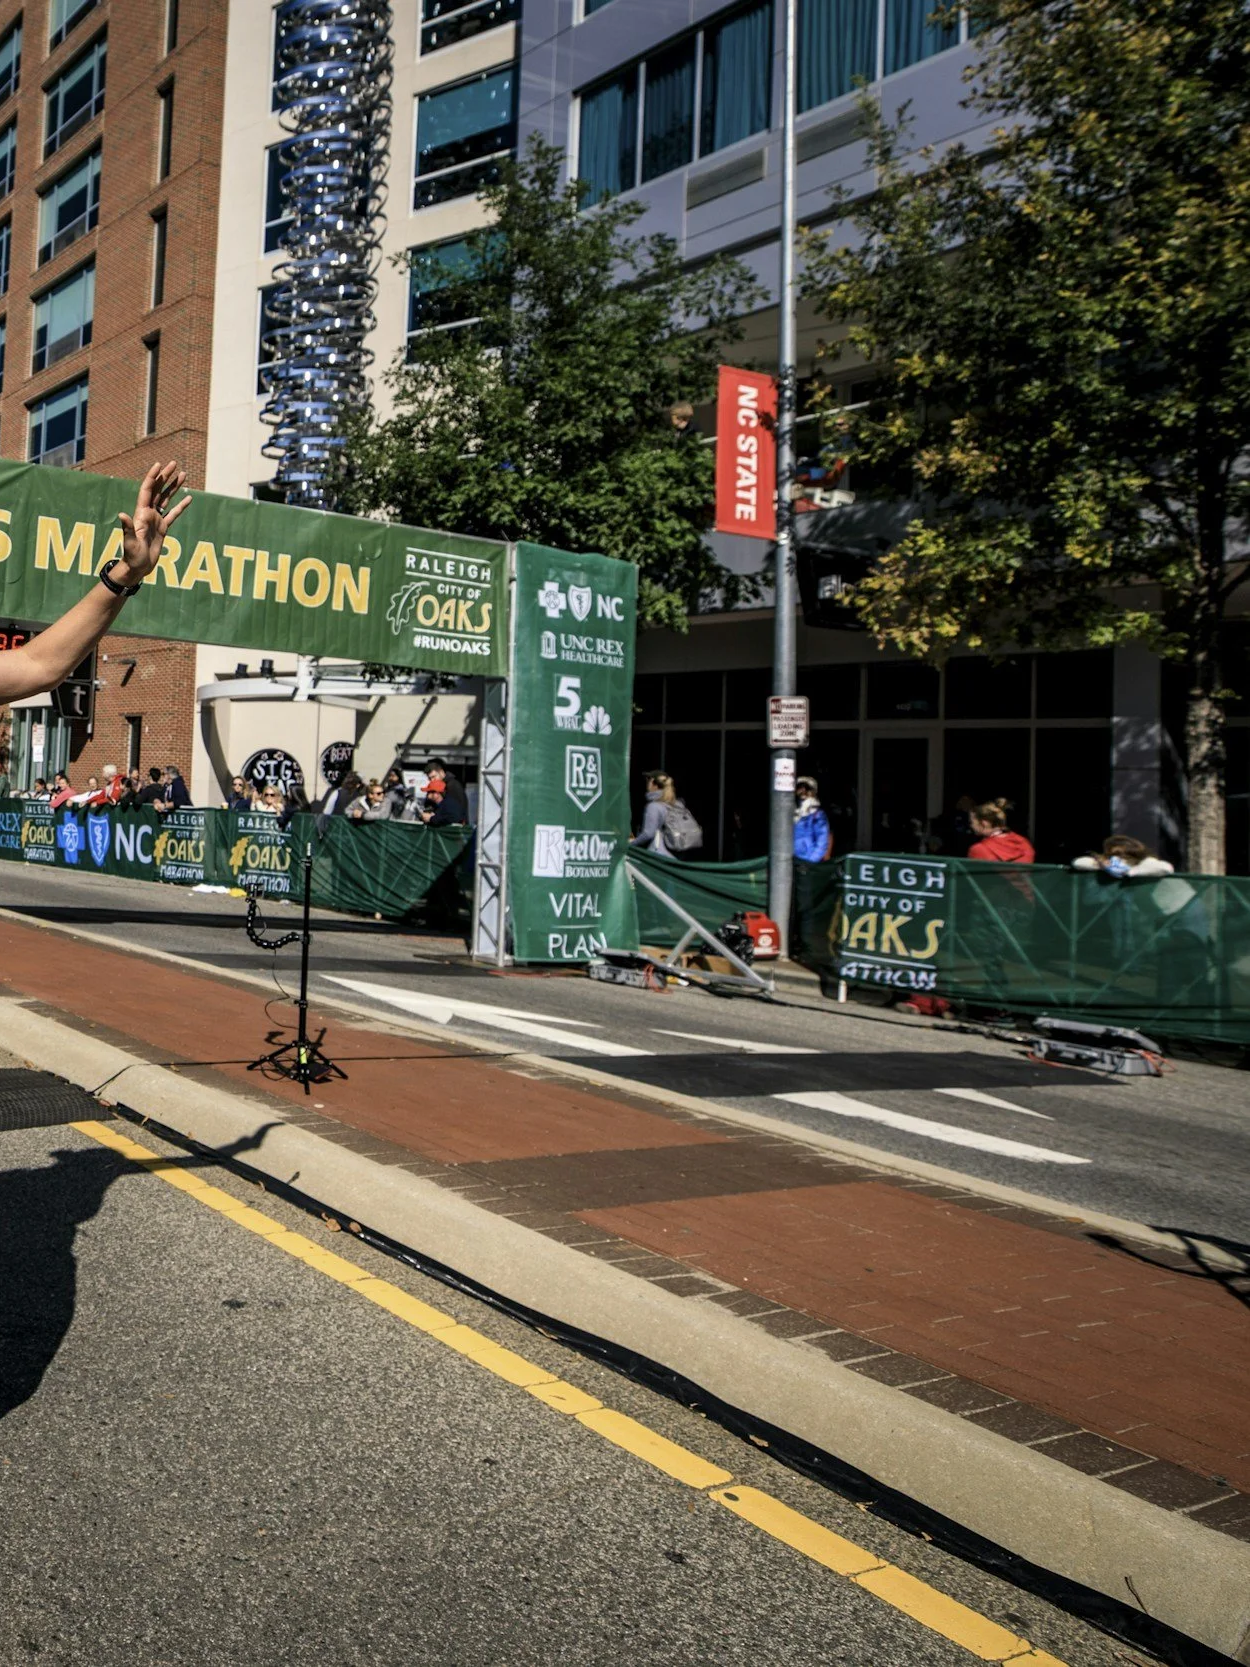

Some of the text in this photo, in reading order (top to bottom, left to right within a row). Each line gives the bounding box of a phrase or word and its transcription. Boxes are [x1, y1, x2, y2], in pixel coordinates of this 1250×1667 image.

[735, 384, 759, 522] NC STATE
[405, 554, 491, 581] RALEIGH
[437, 583, 481, 600] CITY OF
[417, 594, 492, 634] OAKS
[596, 593, 625, 622] NC
[413, 634, 491, 656] #RUNOAKS
[560, 633, 624, 656] UNC REX
[561, 649, 624, 669] HEALTHCARE
[553, 675, 582, 716] 5
[253, 760, 292, 781] SIG
[163, 814, 205, 826] ALEIGH
[28, 825, 55, 845] OAKS
[115, 823, 153, 864] NC
[176, 831, 200, 839] CITY OF
[167, 838, 206, 863] OAKS
[160, 864, 204, 880] MARATHON
[565, 866, 610, 878] BOTANICAL
[548, 892, 602, 918] VITAL
[844, 893, 926, 914] CITY OF
[548, 931, 608, 959] PLAN
